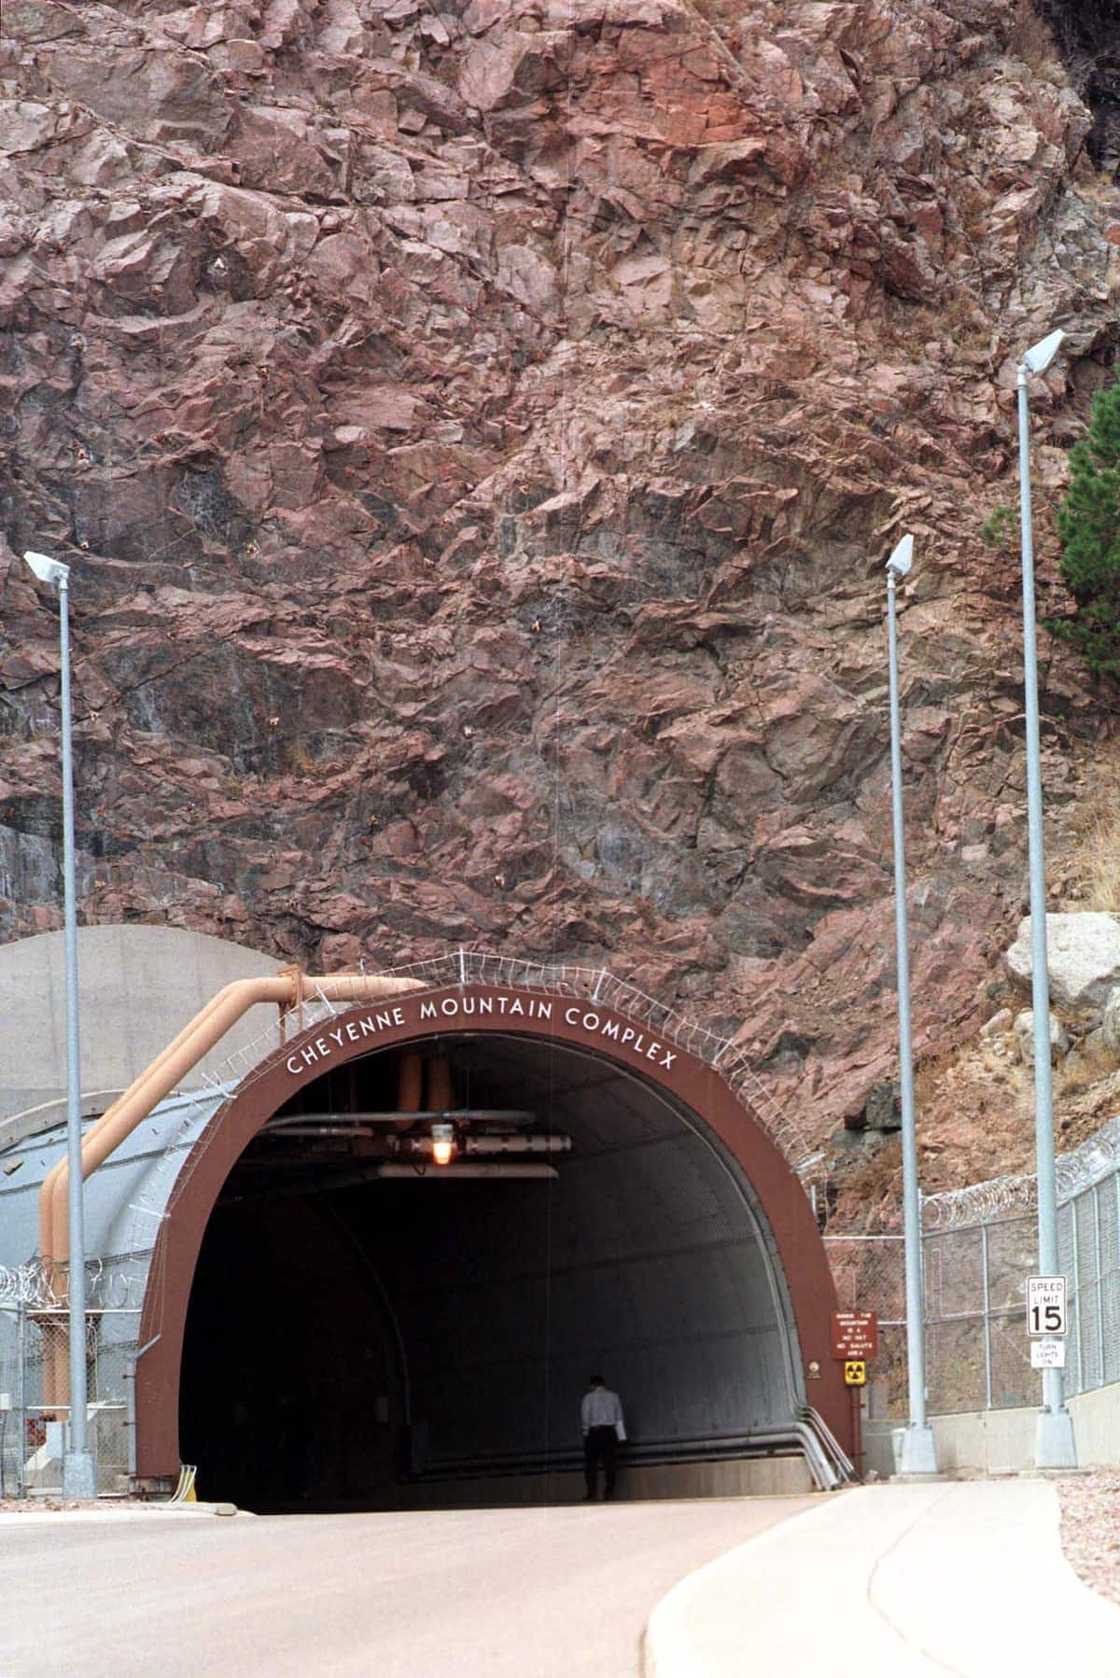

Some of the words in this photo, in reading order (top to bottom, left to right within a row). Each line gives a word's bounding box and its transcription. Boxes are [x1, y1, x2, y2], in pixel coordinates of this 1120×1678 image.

[286, 1007, 406, 1075] CHEYENNE
[419, 996, 552, 1020] MOUNTAIN
[564, 1007, 678, 1071] COMPLEX
[1031, 1283, 1063, 1292] SPEED
[1034, 1295, 1059, 1304] LIMIT
[1032, 1306, 1062, 1331] 15
